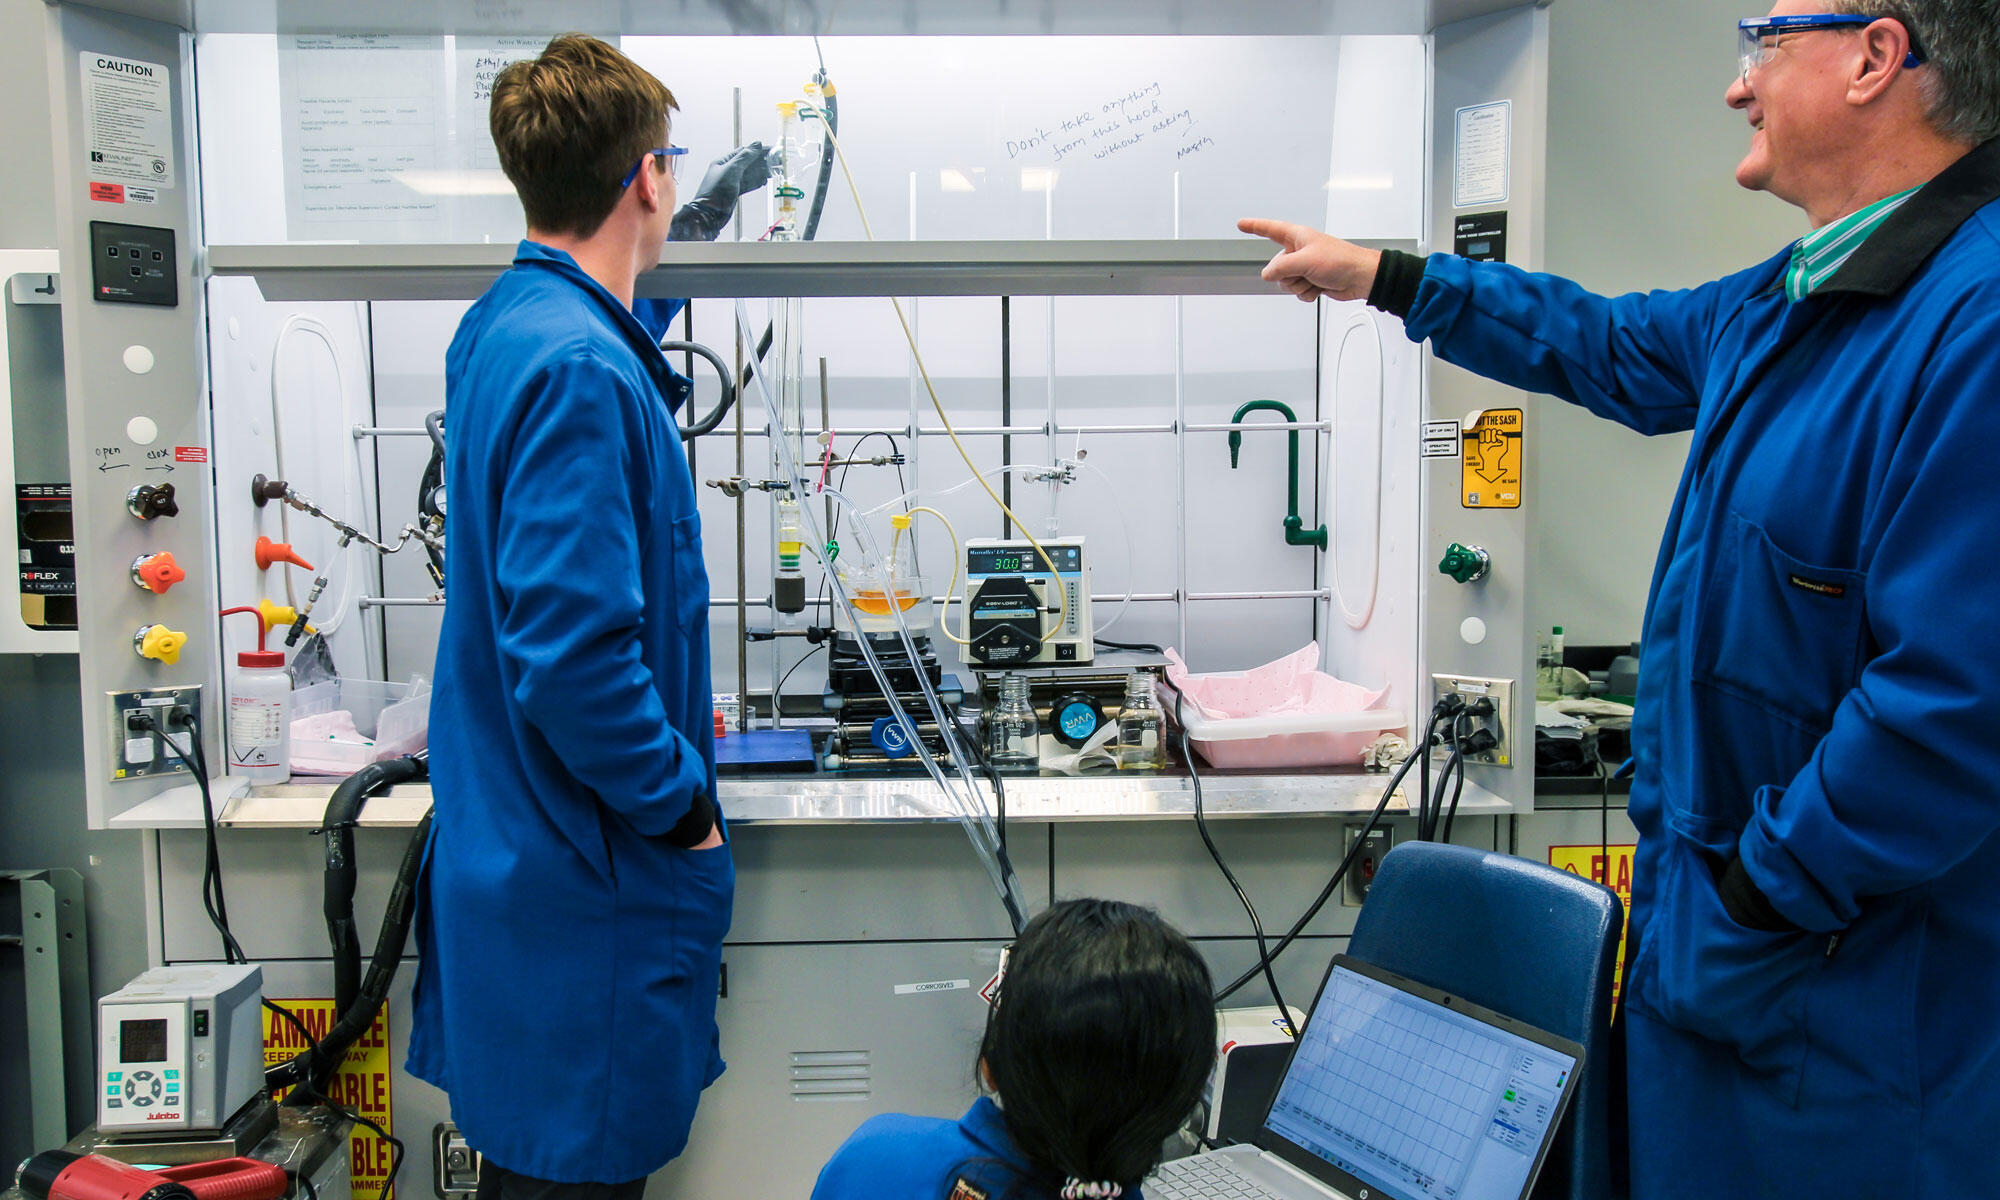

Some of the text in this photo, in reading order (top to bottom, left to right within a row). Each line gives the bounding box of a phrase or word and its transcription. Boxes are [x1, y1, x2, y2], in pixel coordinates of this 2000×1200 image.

[96, 58, 153, 77] CAUTION
[1006, 82, 1161, 160] Don't take anything
[1053, 100, 1163, 162] from this hood
[1094, 109, 1192, 160] without asking
[1486, 415, 1498, 425] THE
[1499, 415, 1517, 425] SASH
[95, 447, 121, 459] open
[995, 558, 1019, 570] 30.0
[1065, 712, 1093, 730] VWR
[888, 727, 903, 743] VWR
[916, 982, 954, 991] CORROSIVES
